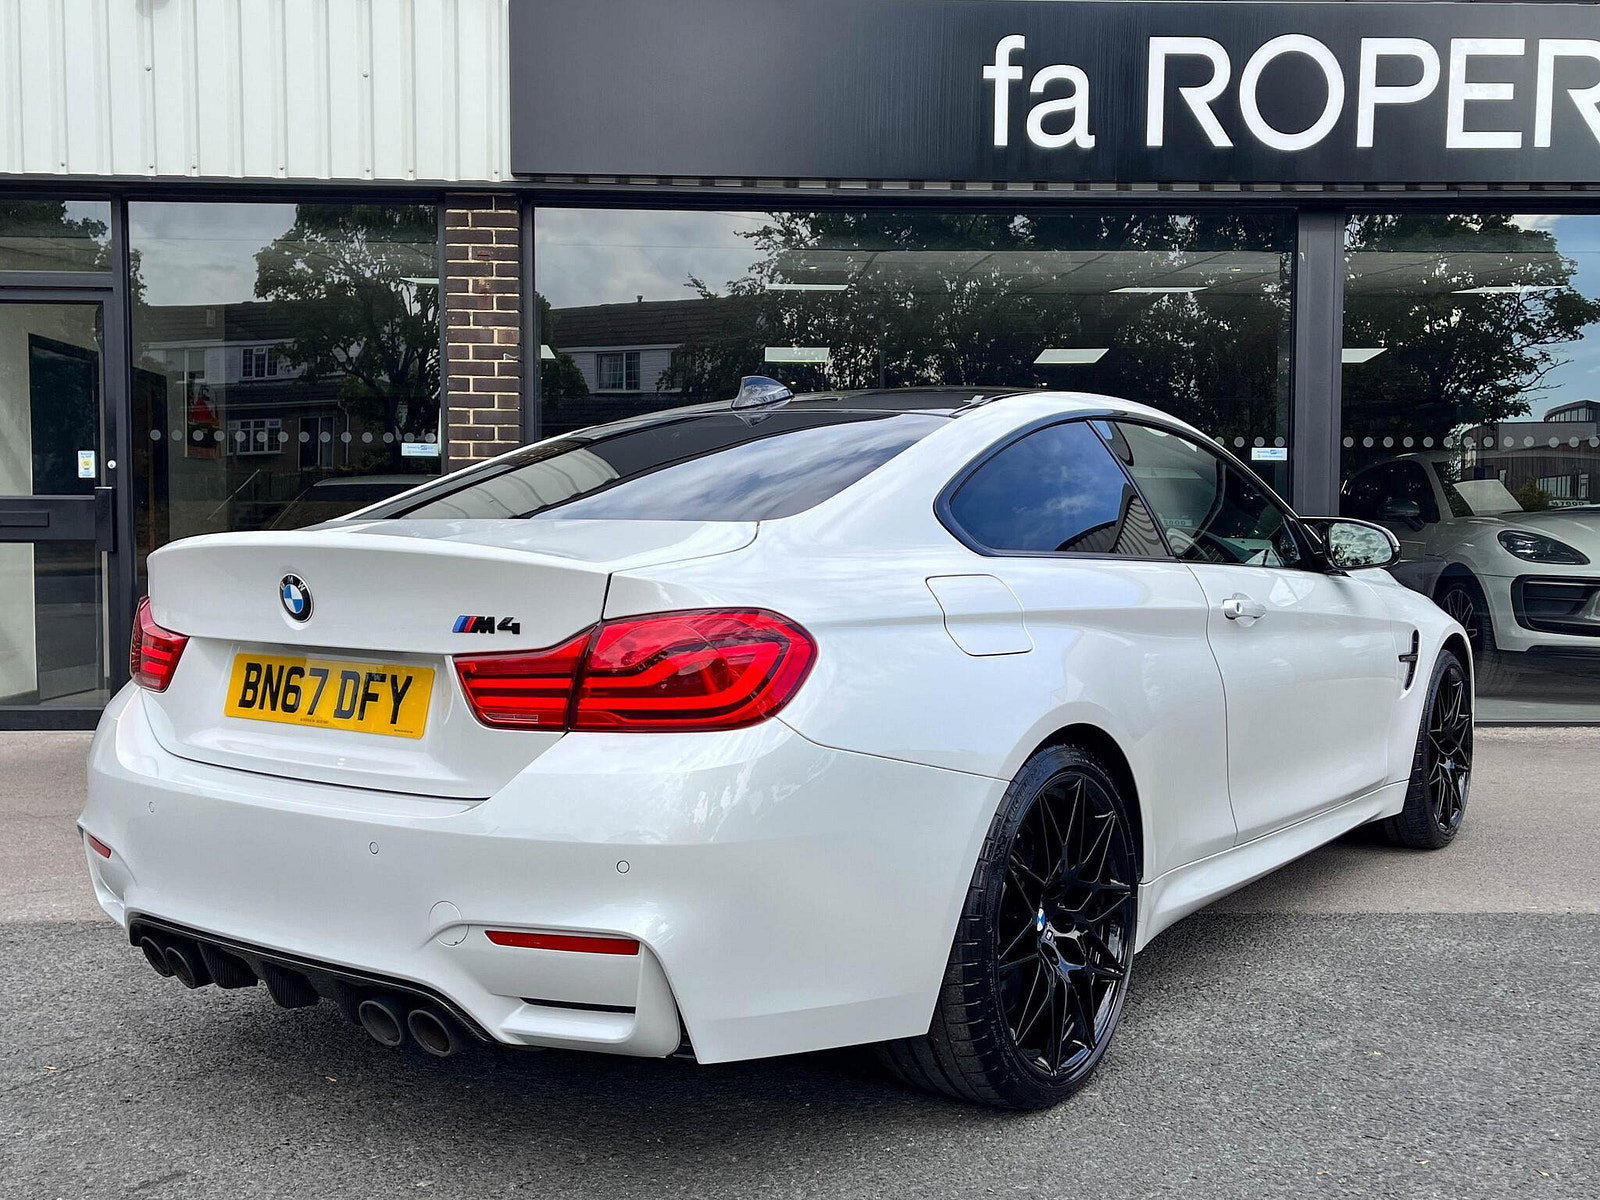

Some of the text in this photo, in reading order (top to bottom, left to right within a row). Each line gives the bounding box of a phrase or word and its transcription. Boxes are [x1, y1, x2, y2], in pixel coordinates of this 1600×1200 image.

[982, 33, 1600, 150] fa ROPER
[468, 615, 521, 635] M4
[238, 662, 413, 725] BN67 DFY
